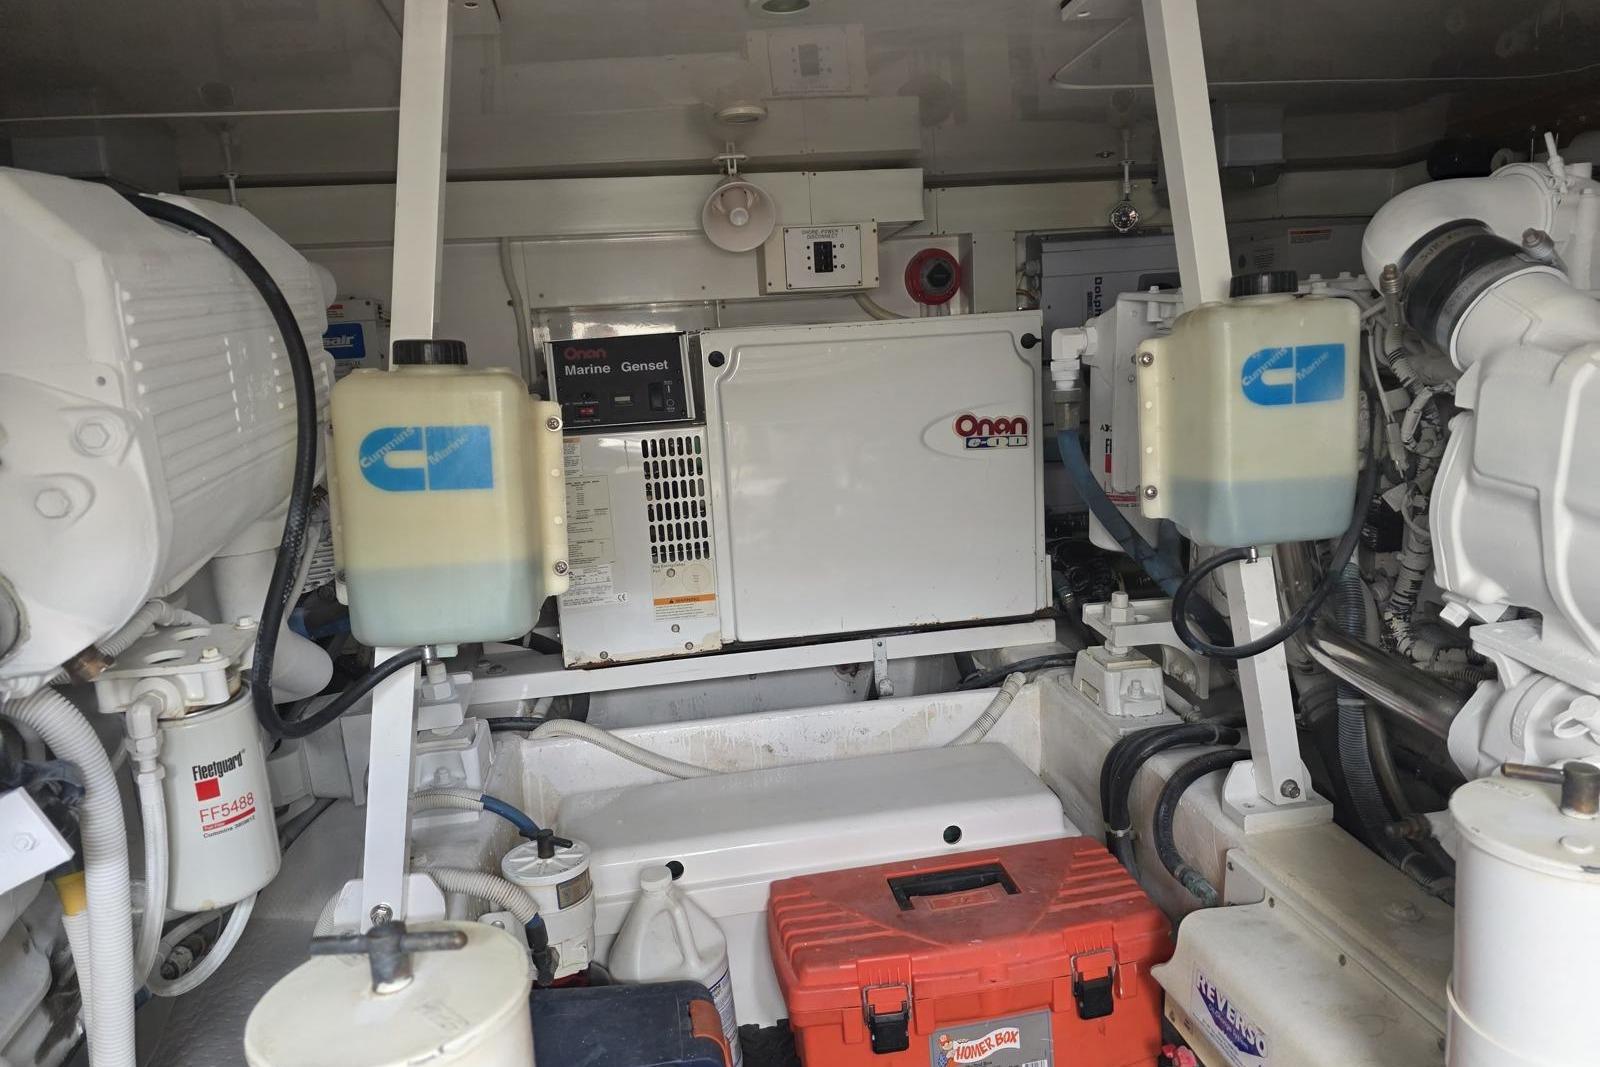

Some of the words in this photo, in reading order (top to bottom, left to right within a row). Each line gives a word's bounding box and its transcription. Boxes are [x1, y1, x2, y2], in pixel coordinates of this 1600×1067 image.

[564, 346, 607, 360] Onan
[564, 363, 611, 376] Marine
[620, 359, 669, 372] Genset
[1242, 347, 1288, 387] Cummins
[1296, 352, 1329, 382] Marine
[955, 414, 1028, 437] Onan
[360, 427, 416, 469] Cummins
[428, 433, 470, 465] Marine
[192, 751, 243, 782] Fleetguard
[199, 792, 255, 823] FF5488
[1196, 973, 1266, 1058] REVERSO
[955, 1036, 996, 1061] HOMER
[994, 1030, 1019, 1047] BOX
